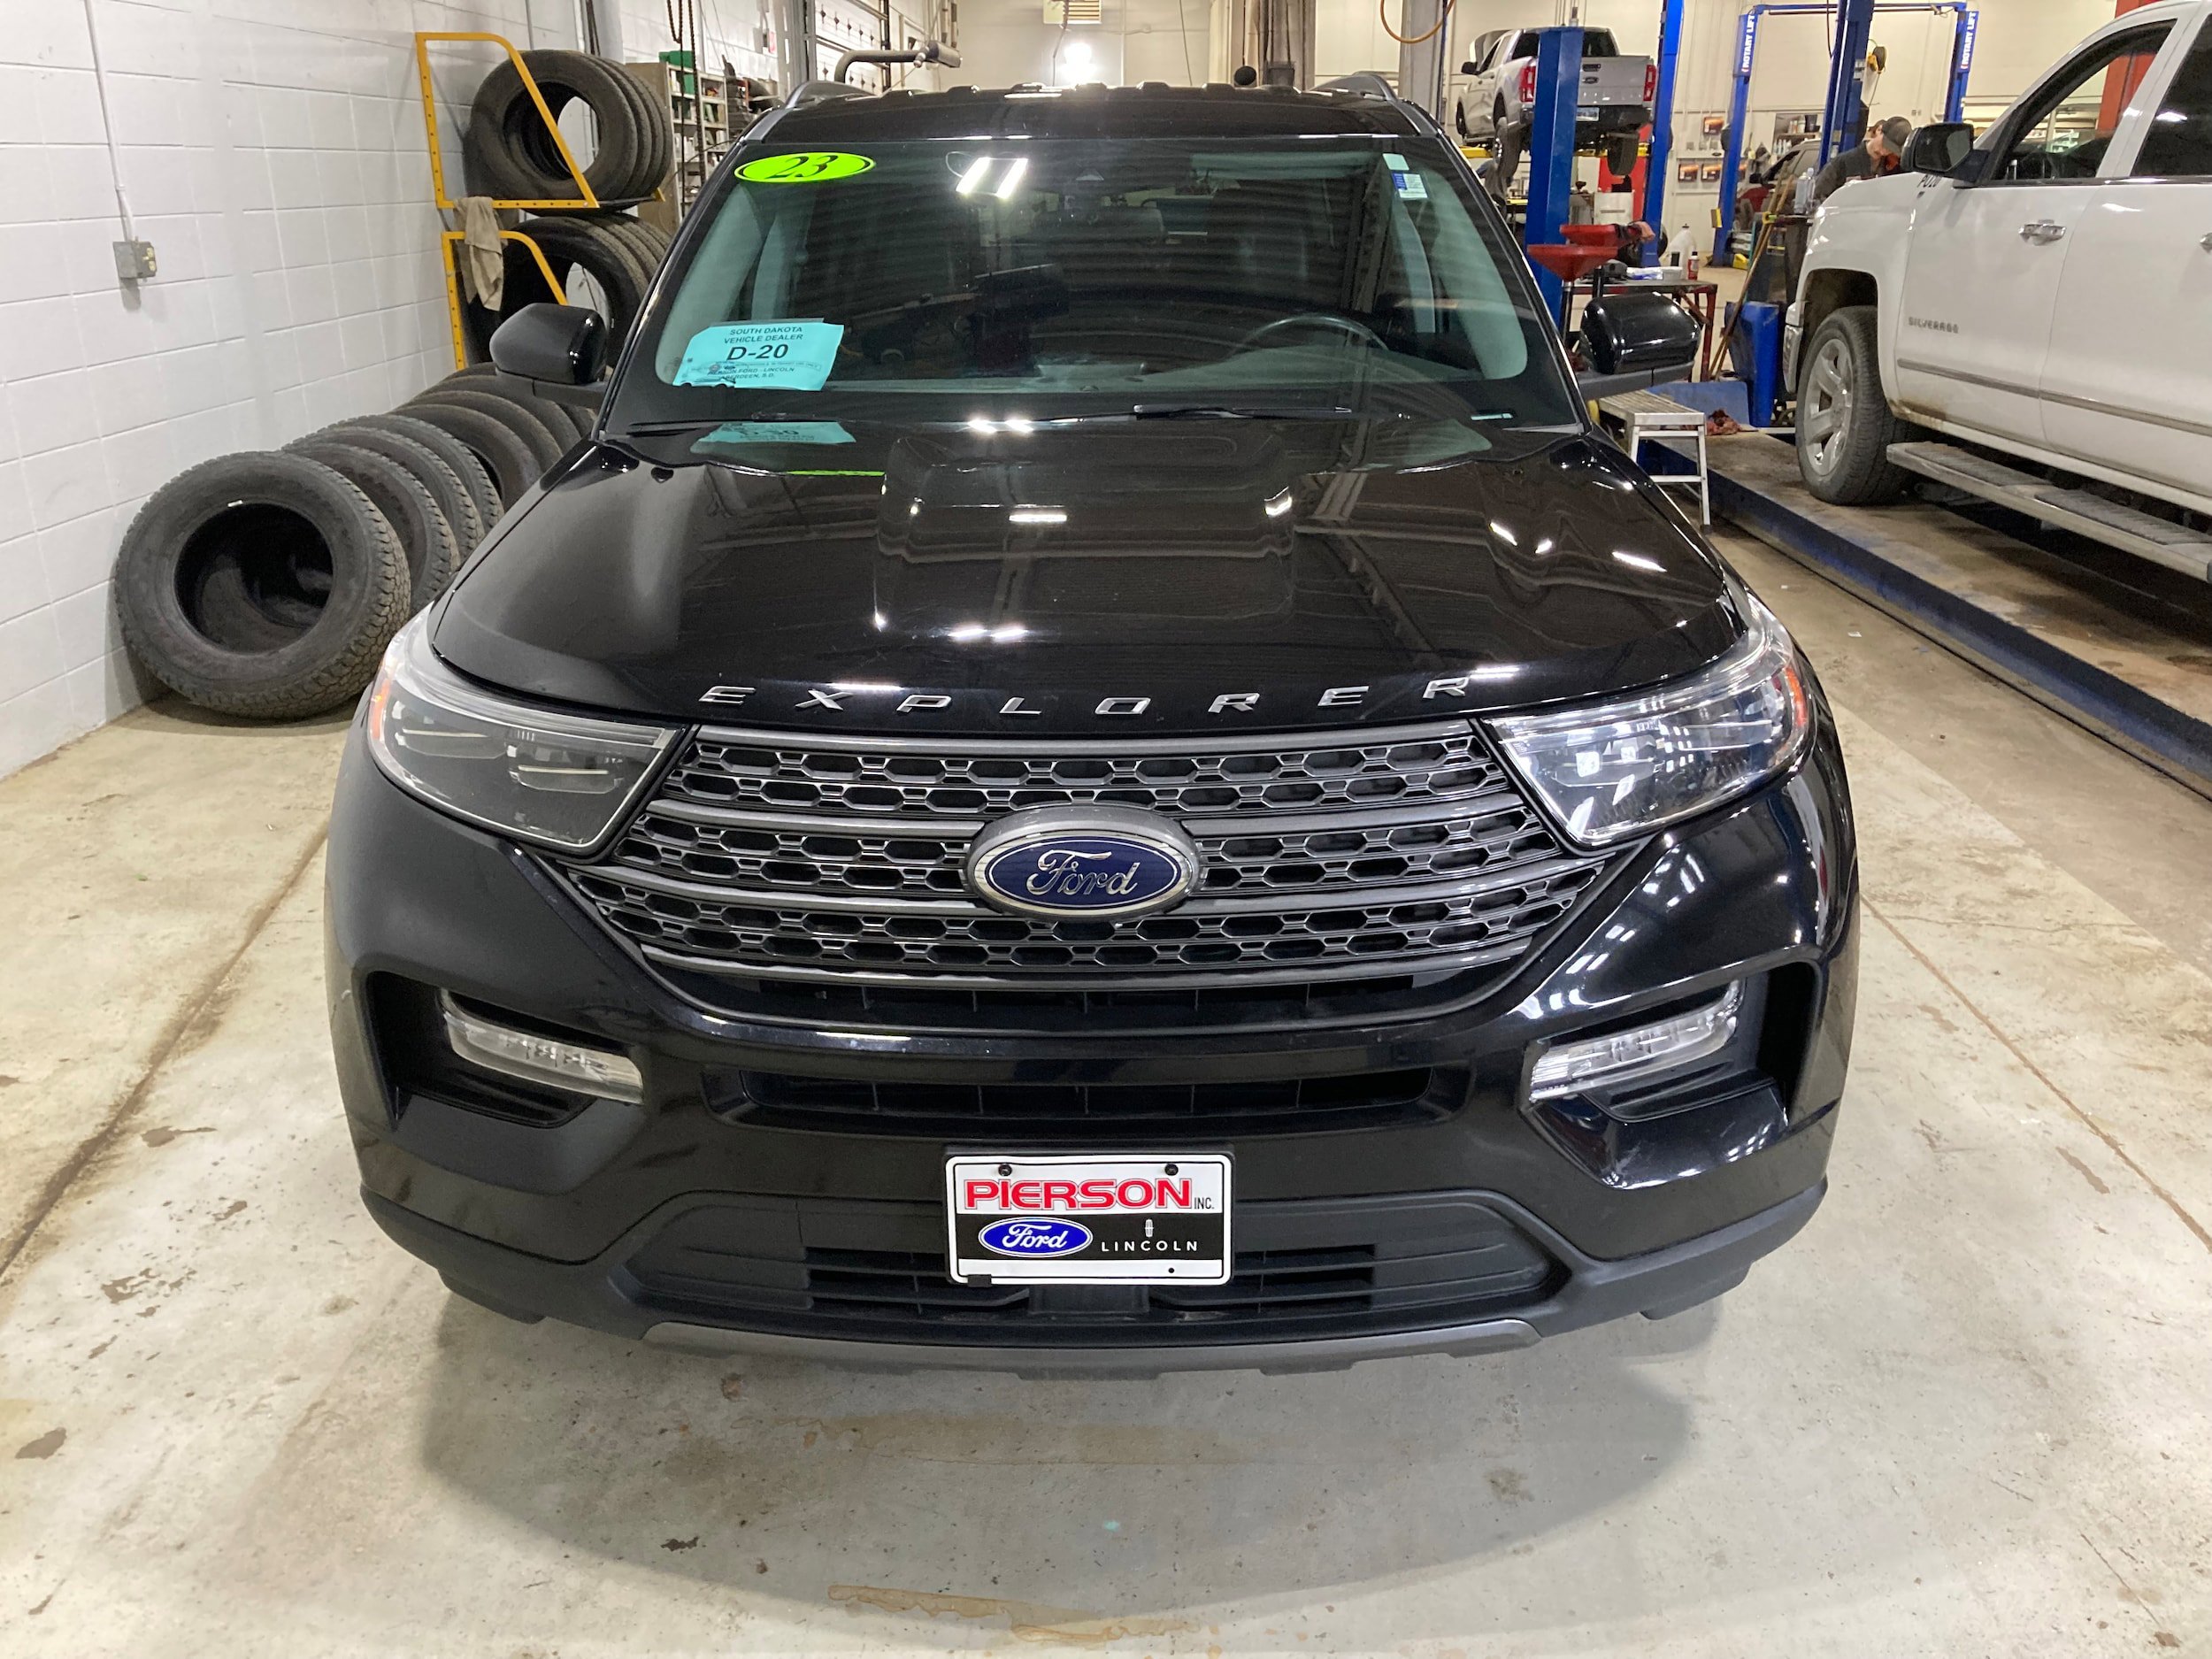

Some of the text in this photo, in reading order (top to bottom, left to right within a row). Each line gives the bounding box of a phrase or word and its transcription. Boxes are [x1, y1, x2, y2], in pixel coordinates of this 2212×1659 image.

[1742, 14, 1755, 67] ROTARY LIFT
[1962, 12, 1977, 65] ROTARY LIFT
[764, 155, 839, 180] 23
[1909, 317, 1959, 334] SILVERADO
[726, 343, 788, 361] D-20
[698, 676, 1469, 716] EXPLORER
[1026, 849, 1141, 895] Ford
[964, 1178, 1215, 1210] PIERSON INC.
[1002, 1223, 1069, 1248] Ford
[1101, 1240, 1197, 1252] LINCOLN
